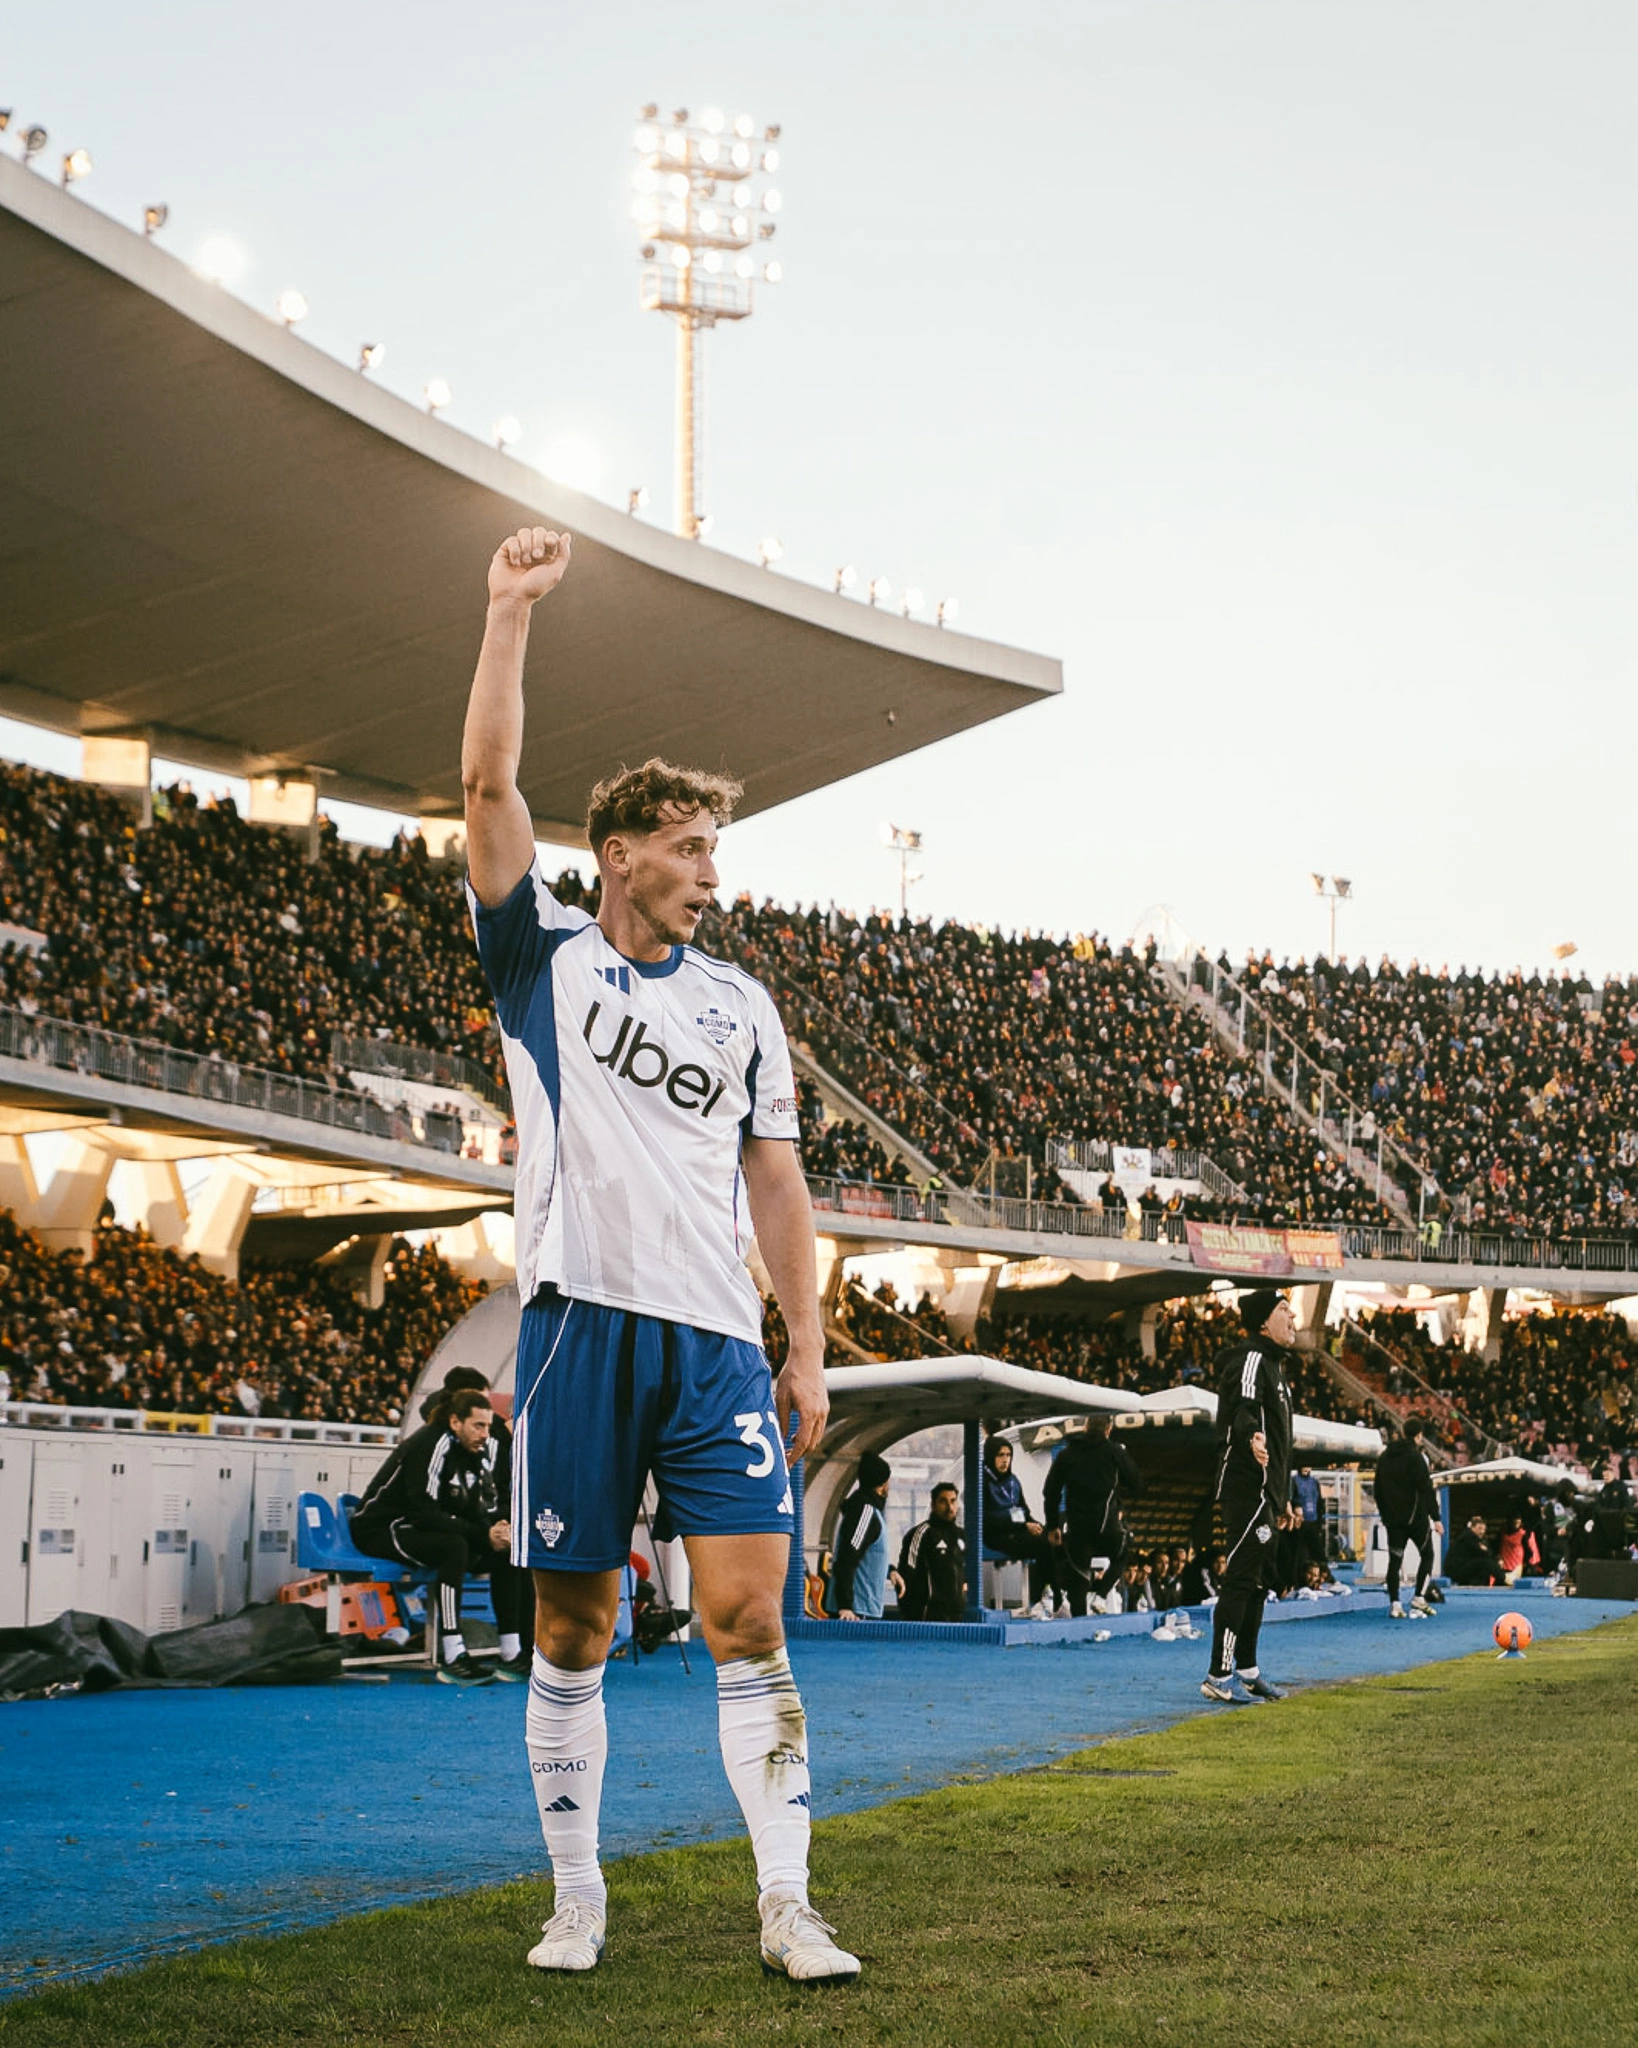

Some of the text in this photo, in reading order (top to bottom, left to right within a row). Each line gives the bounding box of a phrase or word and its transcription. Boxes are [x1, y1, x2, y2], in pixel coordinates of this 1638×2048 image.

[583, 1001, 727, 1118] Uber
[1033, 1410, 1201, 1443] ALOTT
[532, 1760, 588, 1773] COMO
